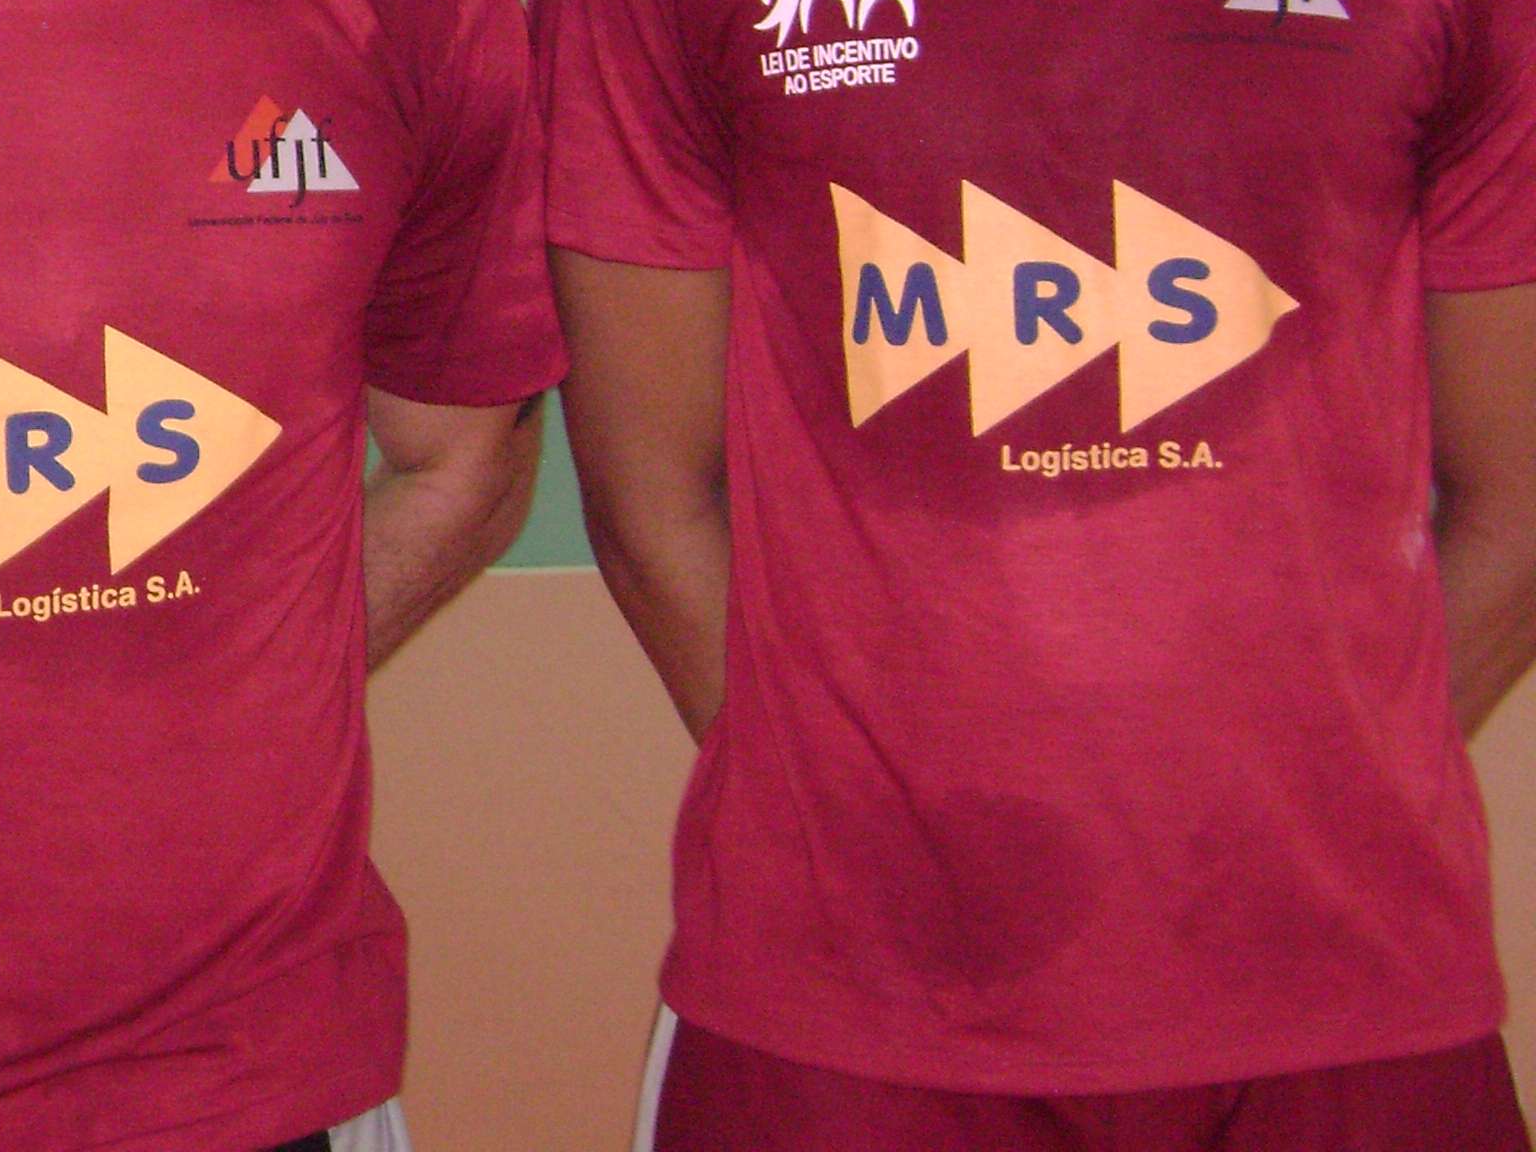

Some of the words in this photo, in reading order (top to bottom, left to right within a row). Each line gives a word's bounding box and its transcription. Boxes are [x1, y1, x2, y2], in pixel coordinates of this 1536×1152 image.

[761, 51, 785, 76] LEI
[785, 48, 811, 69] DE
[813, 36, 919, 67] INCENTIVO
[785, 74, 808, 95] AO
[810, 63, 896, 91] ESPORTE
[1001, 444, 1148, 477] Logística
[1158, 441, 1223, 469] S.A.
[146, 570, 201, 603] S.A.
